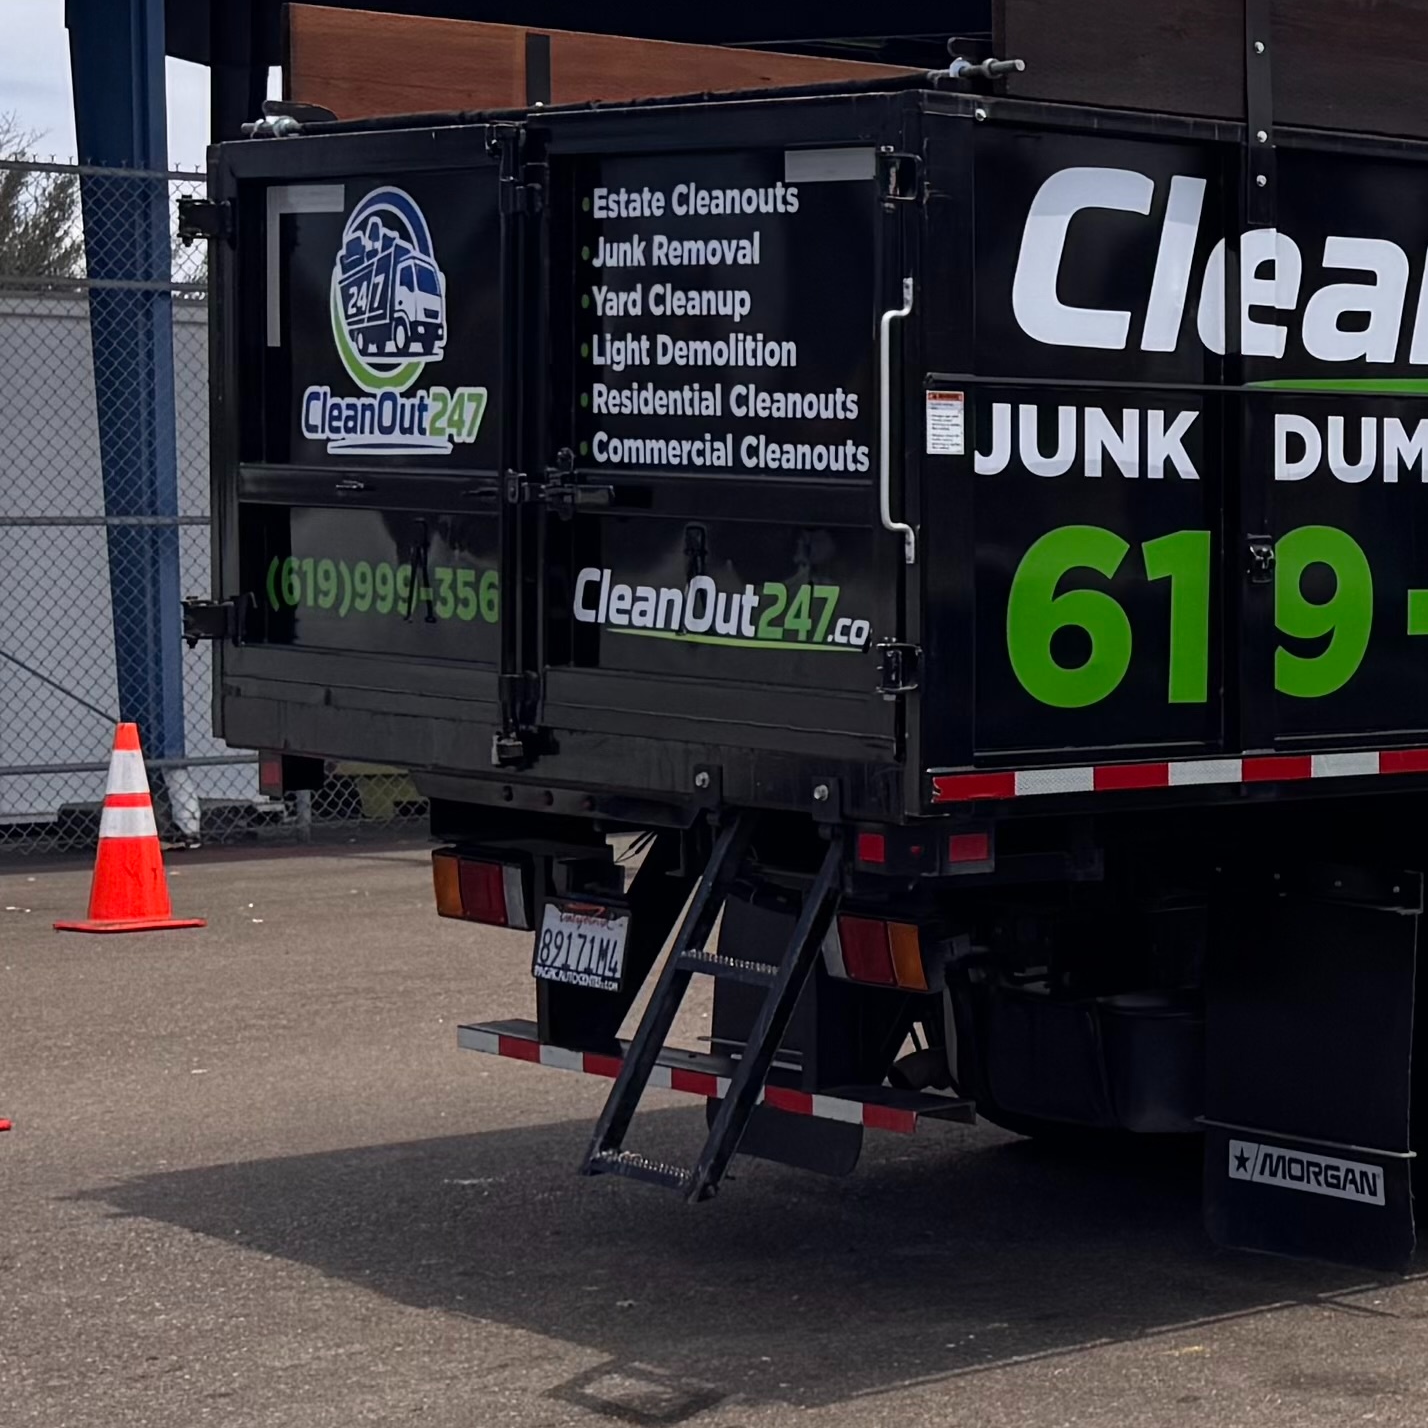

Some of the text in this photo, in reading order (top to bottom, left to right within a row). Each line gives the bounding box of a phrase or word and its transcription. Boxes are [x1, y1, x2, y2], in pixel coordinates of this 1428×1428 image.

[593, 181, 799, 219] Estate Cleanouts
[592, 231, 760, 267] Junk Removal
[591, 283, 751, 322] Yard Cleanup
[592, 332, 797, 371] Light Demolition
[303, 388, 486, 439] CleanOut247
[592, 382, 859, 420] Residential Cleanouts
[592, 430, 870, 472] Commercial Cleanouts
[974, 402, 1200, 479] JUNK
[539, 928, 619, 977] 89171M4
[1258, 1152, 1379, 1198] MORGAN
